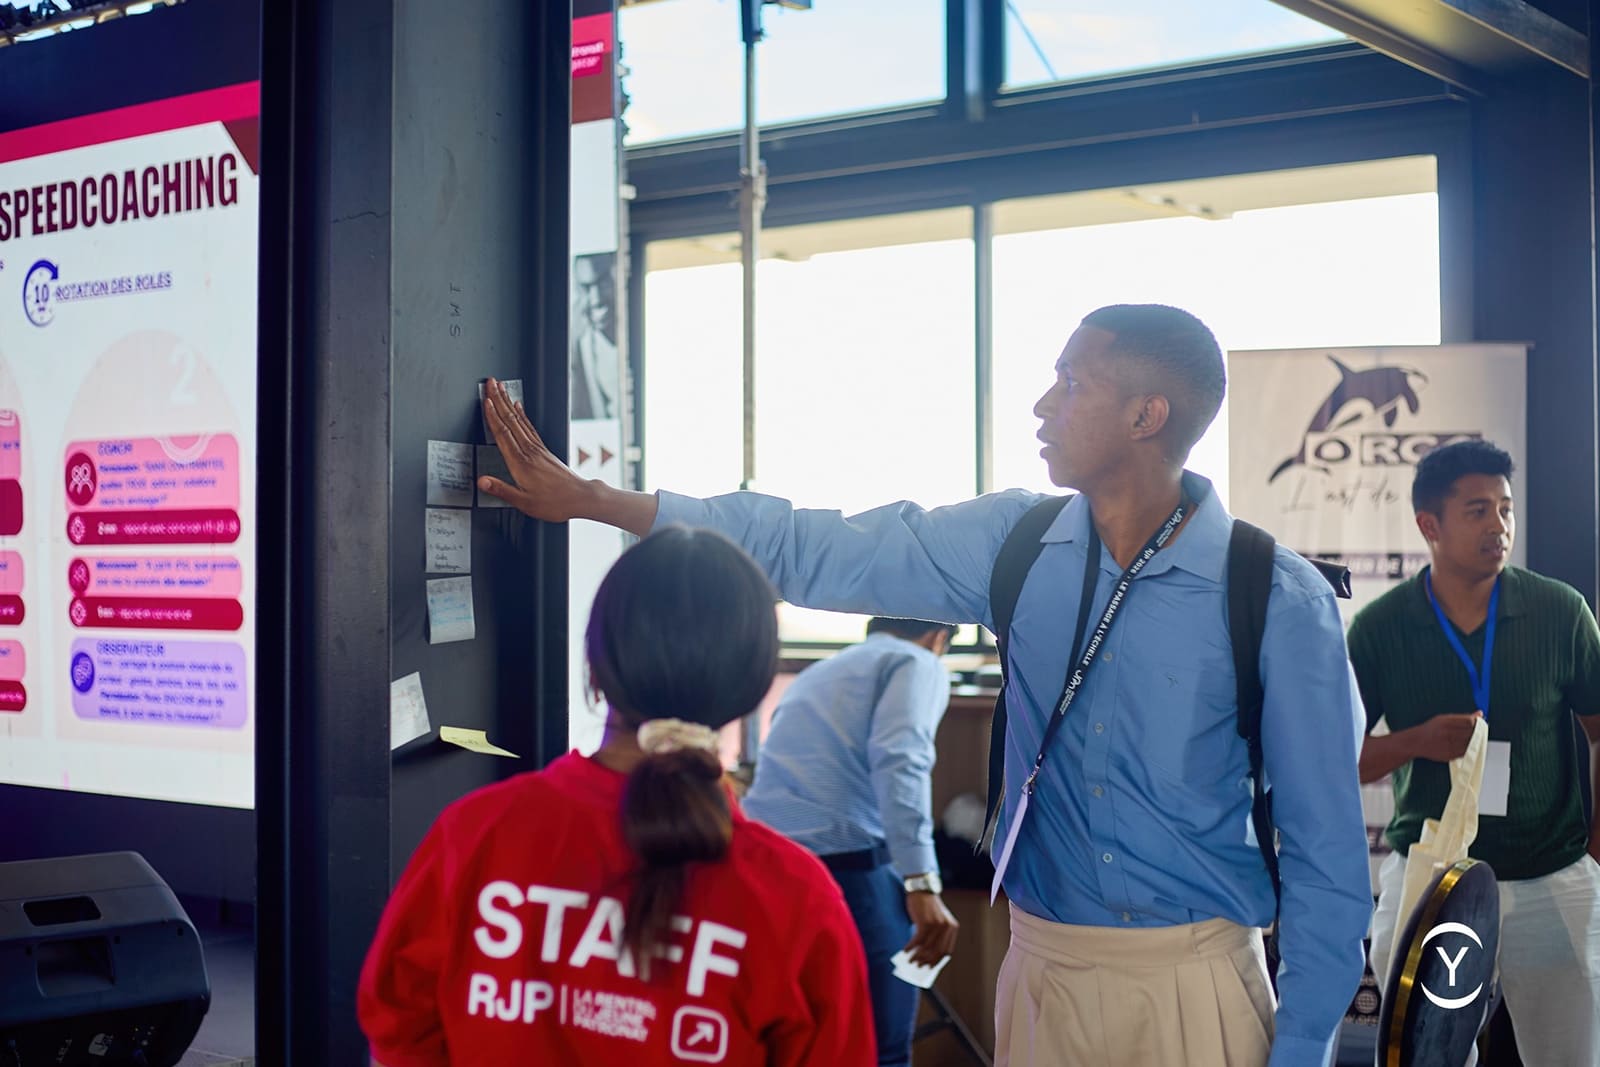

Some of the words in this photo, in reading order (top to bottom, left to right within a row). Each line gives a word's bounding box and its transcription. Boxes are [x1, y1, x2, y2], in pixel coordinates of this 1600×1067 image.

[0, 153, 238, 241] SPEEDCOACHING
[55, 280, 108, 300] ROTATION
[111, 277, 132, 295] DES
[1313, 433, 1478, 466] ORC
[1130, 558, 1146, 574] 2026
[1104, 590, 1124, 625] PASSAGE
[468, 973, 554, 1024] RJP
